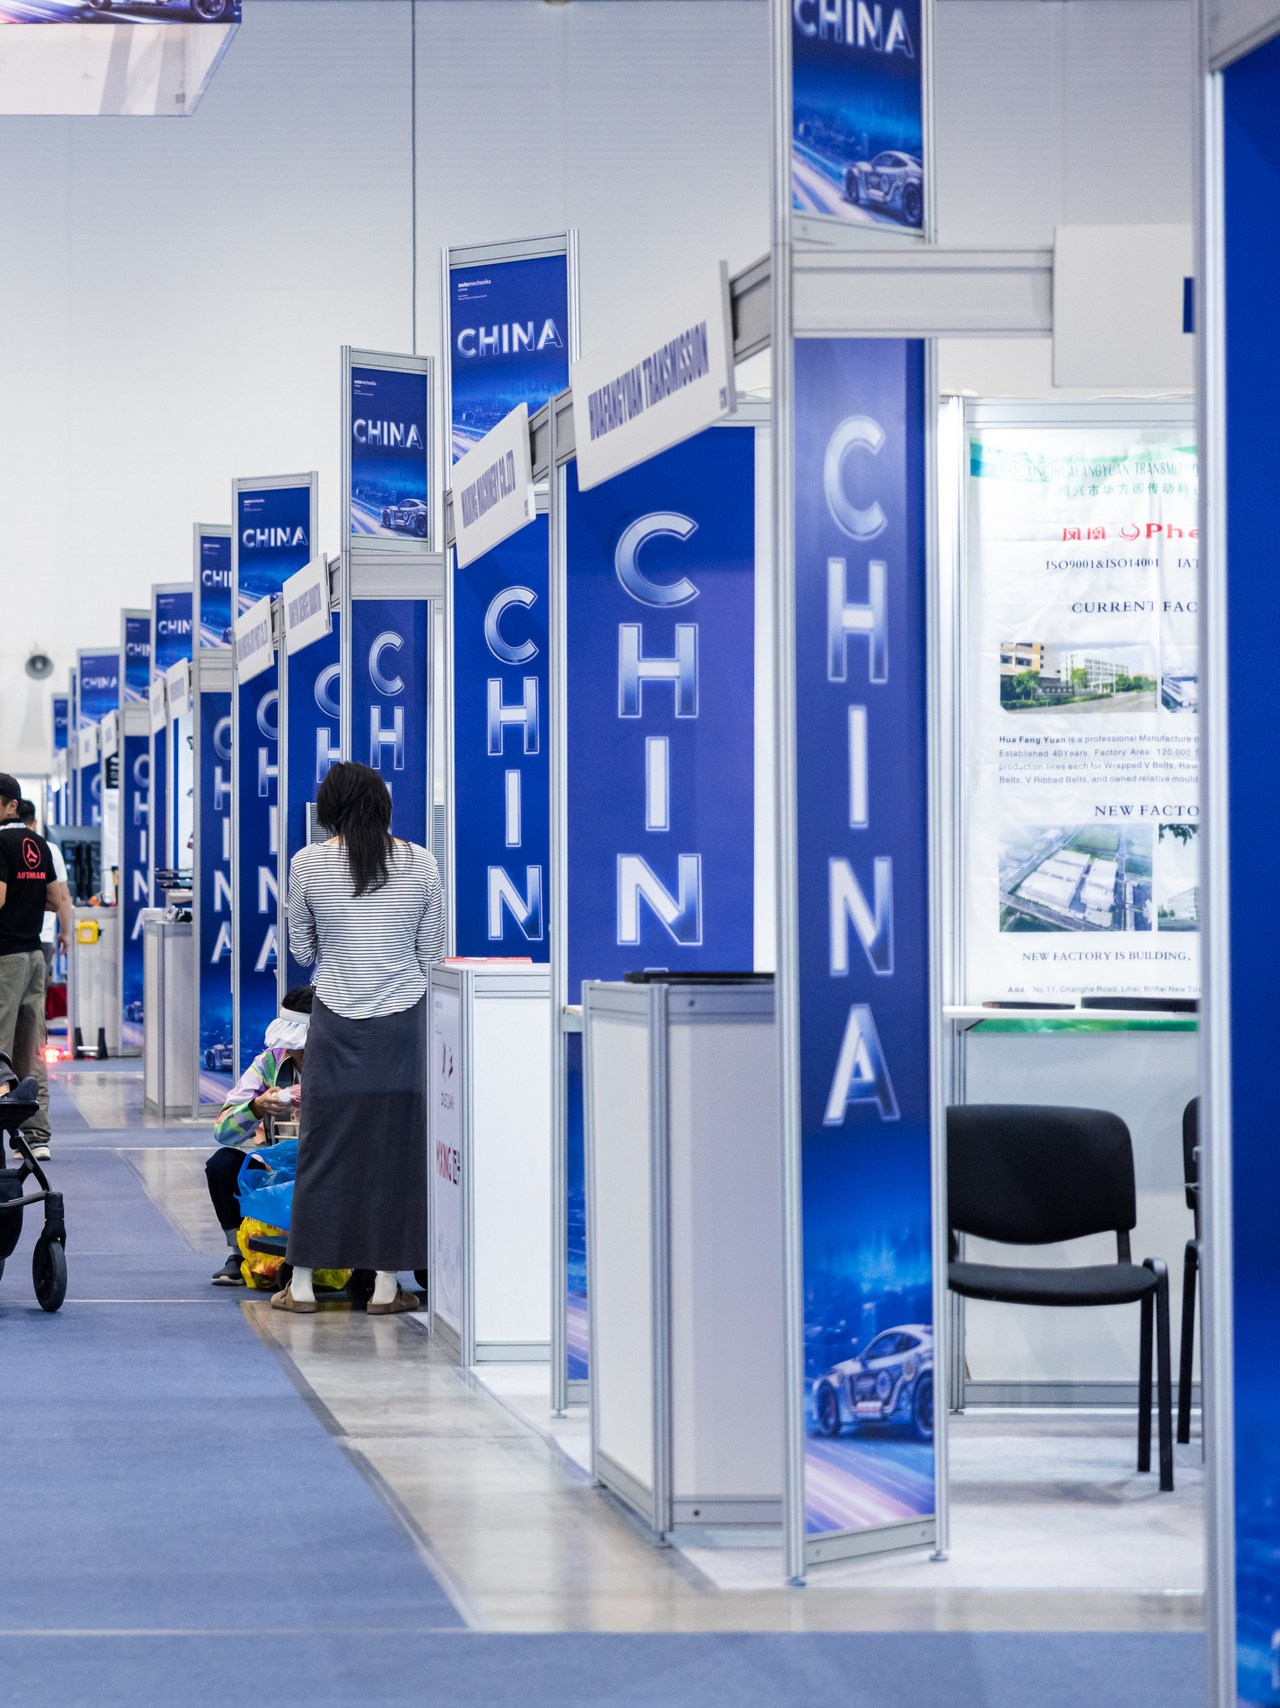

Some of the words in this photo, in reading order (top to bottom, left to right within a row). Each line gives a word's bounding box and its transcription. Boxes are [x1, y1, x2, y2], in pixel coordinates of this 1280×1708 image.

[793, 0, 915, 58] CHINA
[457, 318, 563, 358] CHINA
[642, 318, 710, 408] TRANSMISSION
[353, 418, 423, 449] CHINA
[1054, 462, 1130, 478] HUAFANGYUAN
[243, 527, 309, 548] CHINA
[1046, 558, 1160, 570] ISO9001&ISO14001
[202, 569, 232, 588] CHI
[1071, 601, 1155, 613] CURRENT
[158, 619, 192, 635] CHIN
[614, 510, 704, 972] CHIN
[999, 735, 1017, 744] Hua
[1019, 735, 1041, 745] Fang
[1043, 736, 1066, 744] Yuan
[1068, 735, 1076, 743] is
[1085, 735, 1137, 745] professional
[1139, 734, 1192, 743] Manufacture
[999, 749, 1049, 757] Established
[1094, 748, 1126, 758] Factory
[483, 584, 544, 942] CHIN
[822, 414, 902, 1126] CHINA
[999, 762, 1044, 771] production
[1046, 762, 1066, 770] lines
[1067, 762, 1089, 770] each
[1090, 761, 1102, 770] for
[1104, 761, 1142, 771] Wrapped
[1144, 761, 1150, 769] V
[1179, 761, 1198, 770] Raw
[1025, 775, 1032, 784] V
[1033, 775, 1063, 784] Ribbed
[1091, 775, 1107, 783] and
[1109, 775, 1137, 783] owned
[1138, 775, 1170, 783] relative
[1094, 805, 1134, 817] NEW
[1139, 804, 1200, 817] FACTO
[1022, 951, 1050, 962] NEW
[1053, 951, 1112, 962] FACTORY
[1114, 951, 1126, 961] IS
[1168, 984, 1186, 993] New
